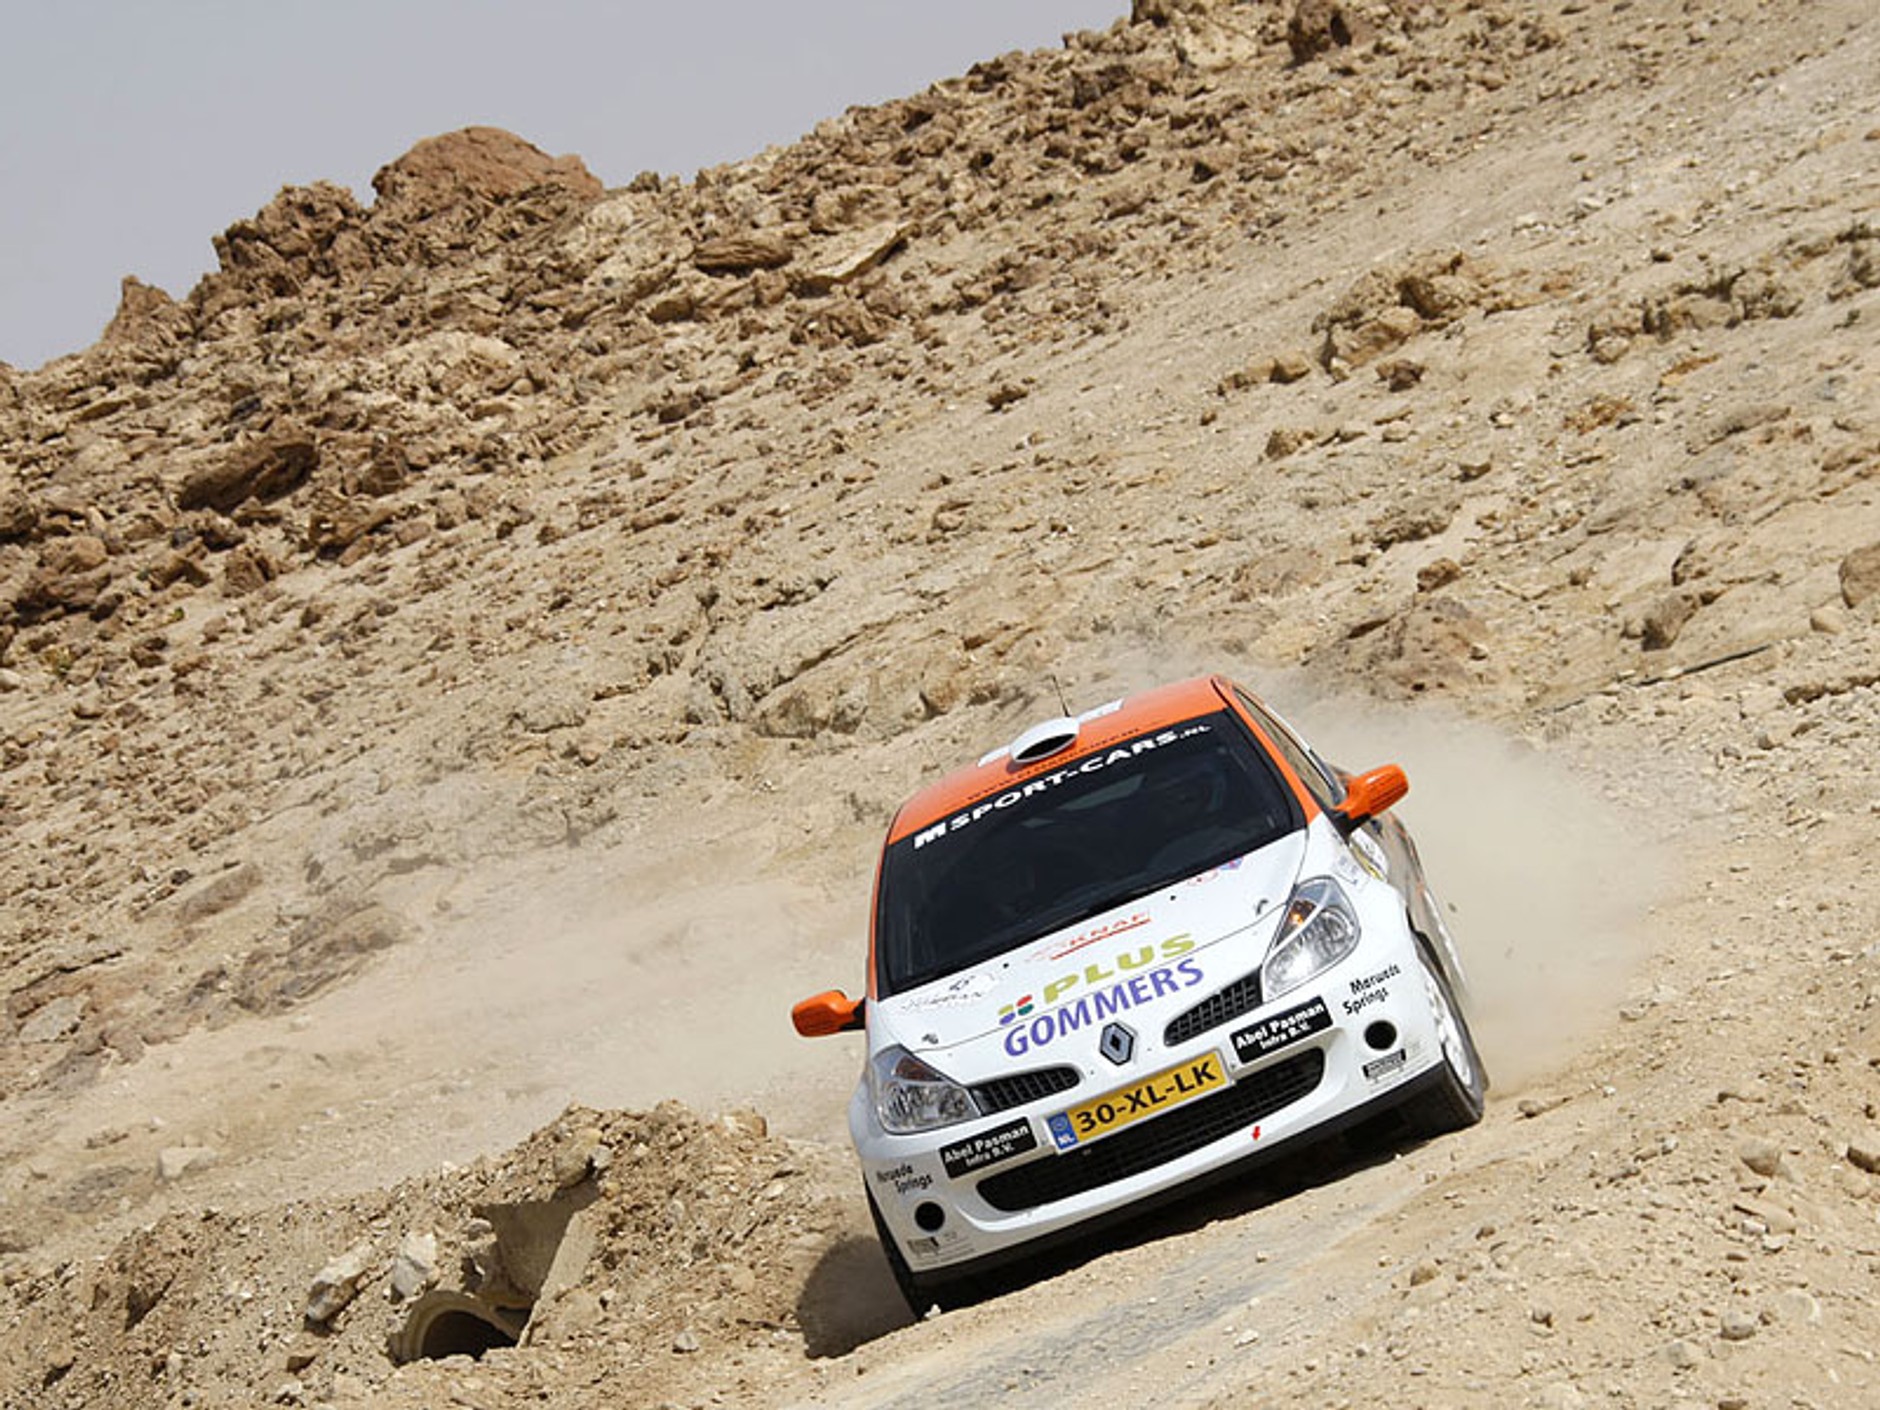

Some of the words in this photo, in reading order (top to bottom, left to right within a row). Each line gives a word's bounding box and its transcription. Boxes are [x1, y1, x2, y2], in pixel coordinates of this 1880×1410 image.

[1043, 933, 1196, 1004] PLUS
[1003, 957, 1204, 1057] GOMMERS
[1342, 986, 1389, 1016] Springs
[1236, 1025, 1268, 1049] Abel
[1269, 1003, 1325, 1034] Pasman
[1076, 1061, 1217, 1134] 30-XL-LK
[944, 1144, 974, 1164] Abel
[975, 1125, 1029, 1152] Pasman
[895, 1174, 934, 1195] Springs
